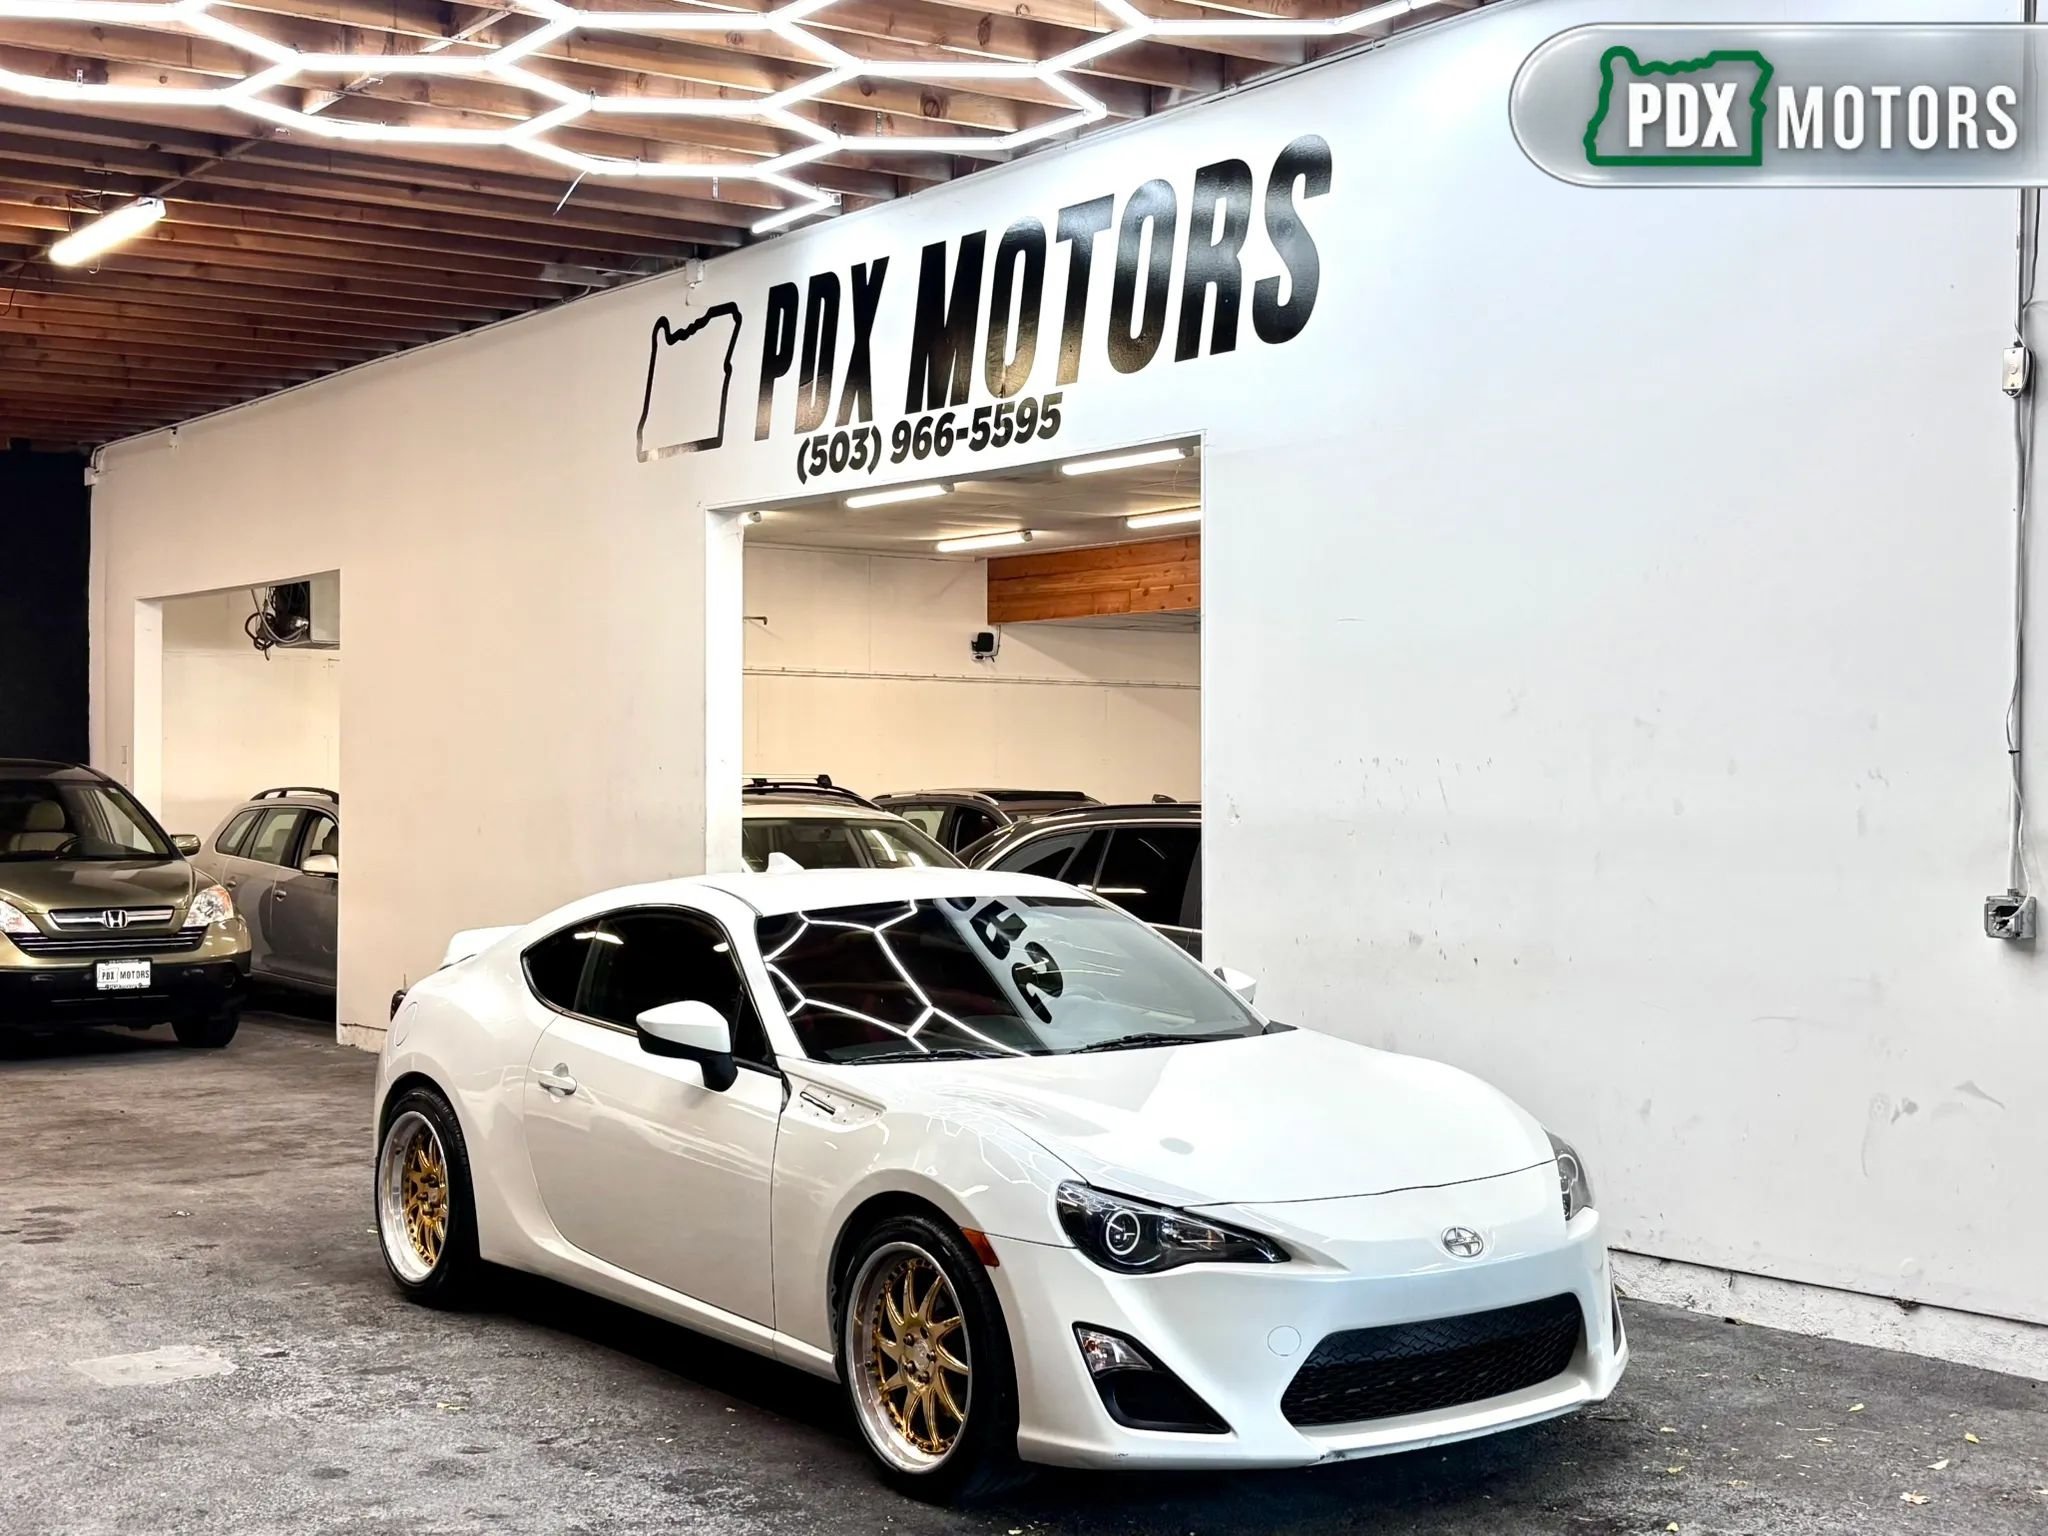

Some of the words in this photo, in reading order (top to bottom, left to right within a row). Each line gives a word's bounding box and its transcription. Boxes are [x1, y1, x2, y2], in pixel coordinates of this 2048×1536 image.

[754, 255, 890, 441] PDX
[906, 134, 1333, 415] MOTORS
[797, 428, 883, 484] (503)
[890, 391, 1063, 464] 966-5595
[102, 971, 114, 980] PDX
[120, 970, 150, 979] MOTORS
